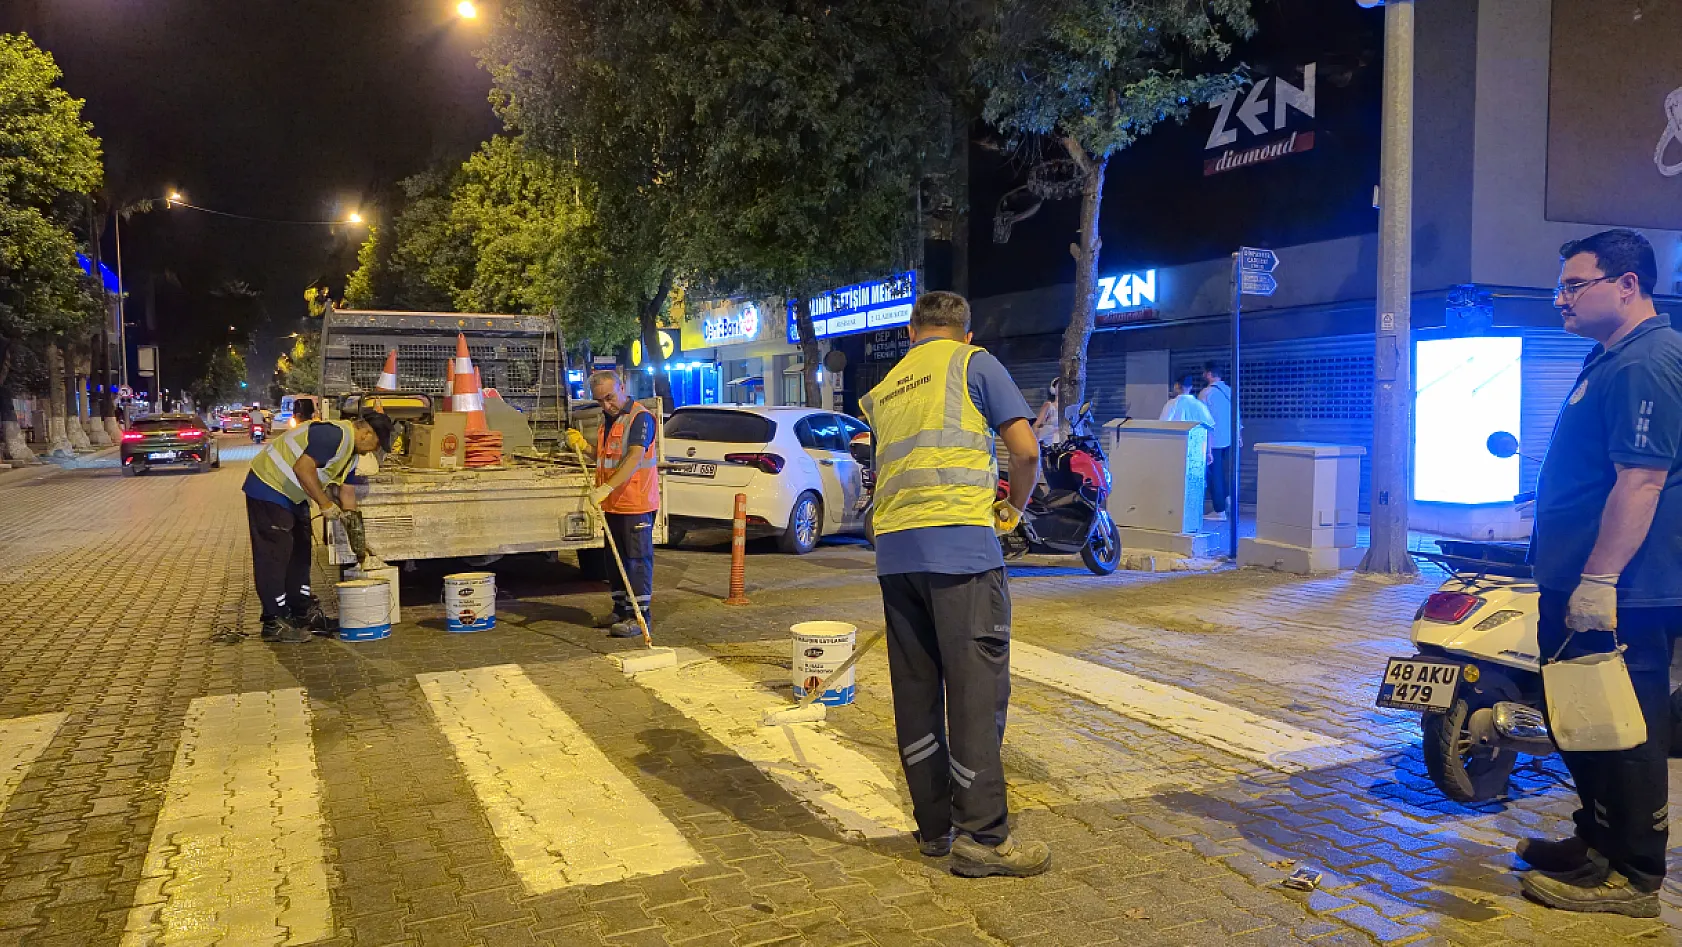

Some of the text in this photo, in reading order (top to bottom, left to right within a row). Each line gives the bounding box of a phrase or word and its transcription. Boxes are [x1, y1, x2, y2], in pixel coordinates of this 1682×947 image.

[1204, 61, 1316, 150] ZEN
[1215, 131, 1297, 171] diamond
[871, 273, 912, 305] MEREİ
[1096, 269, 1156, 309] ZEN
[703, 317, 744, 340] DenizBank
[1390, 663, 1455, 685] 48 AKU
[1395, 682, 1433, 702] 479
